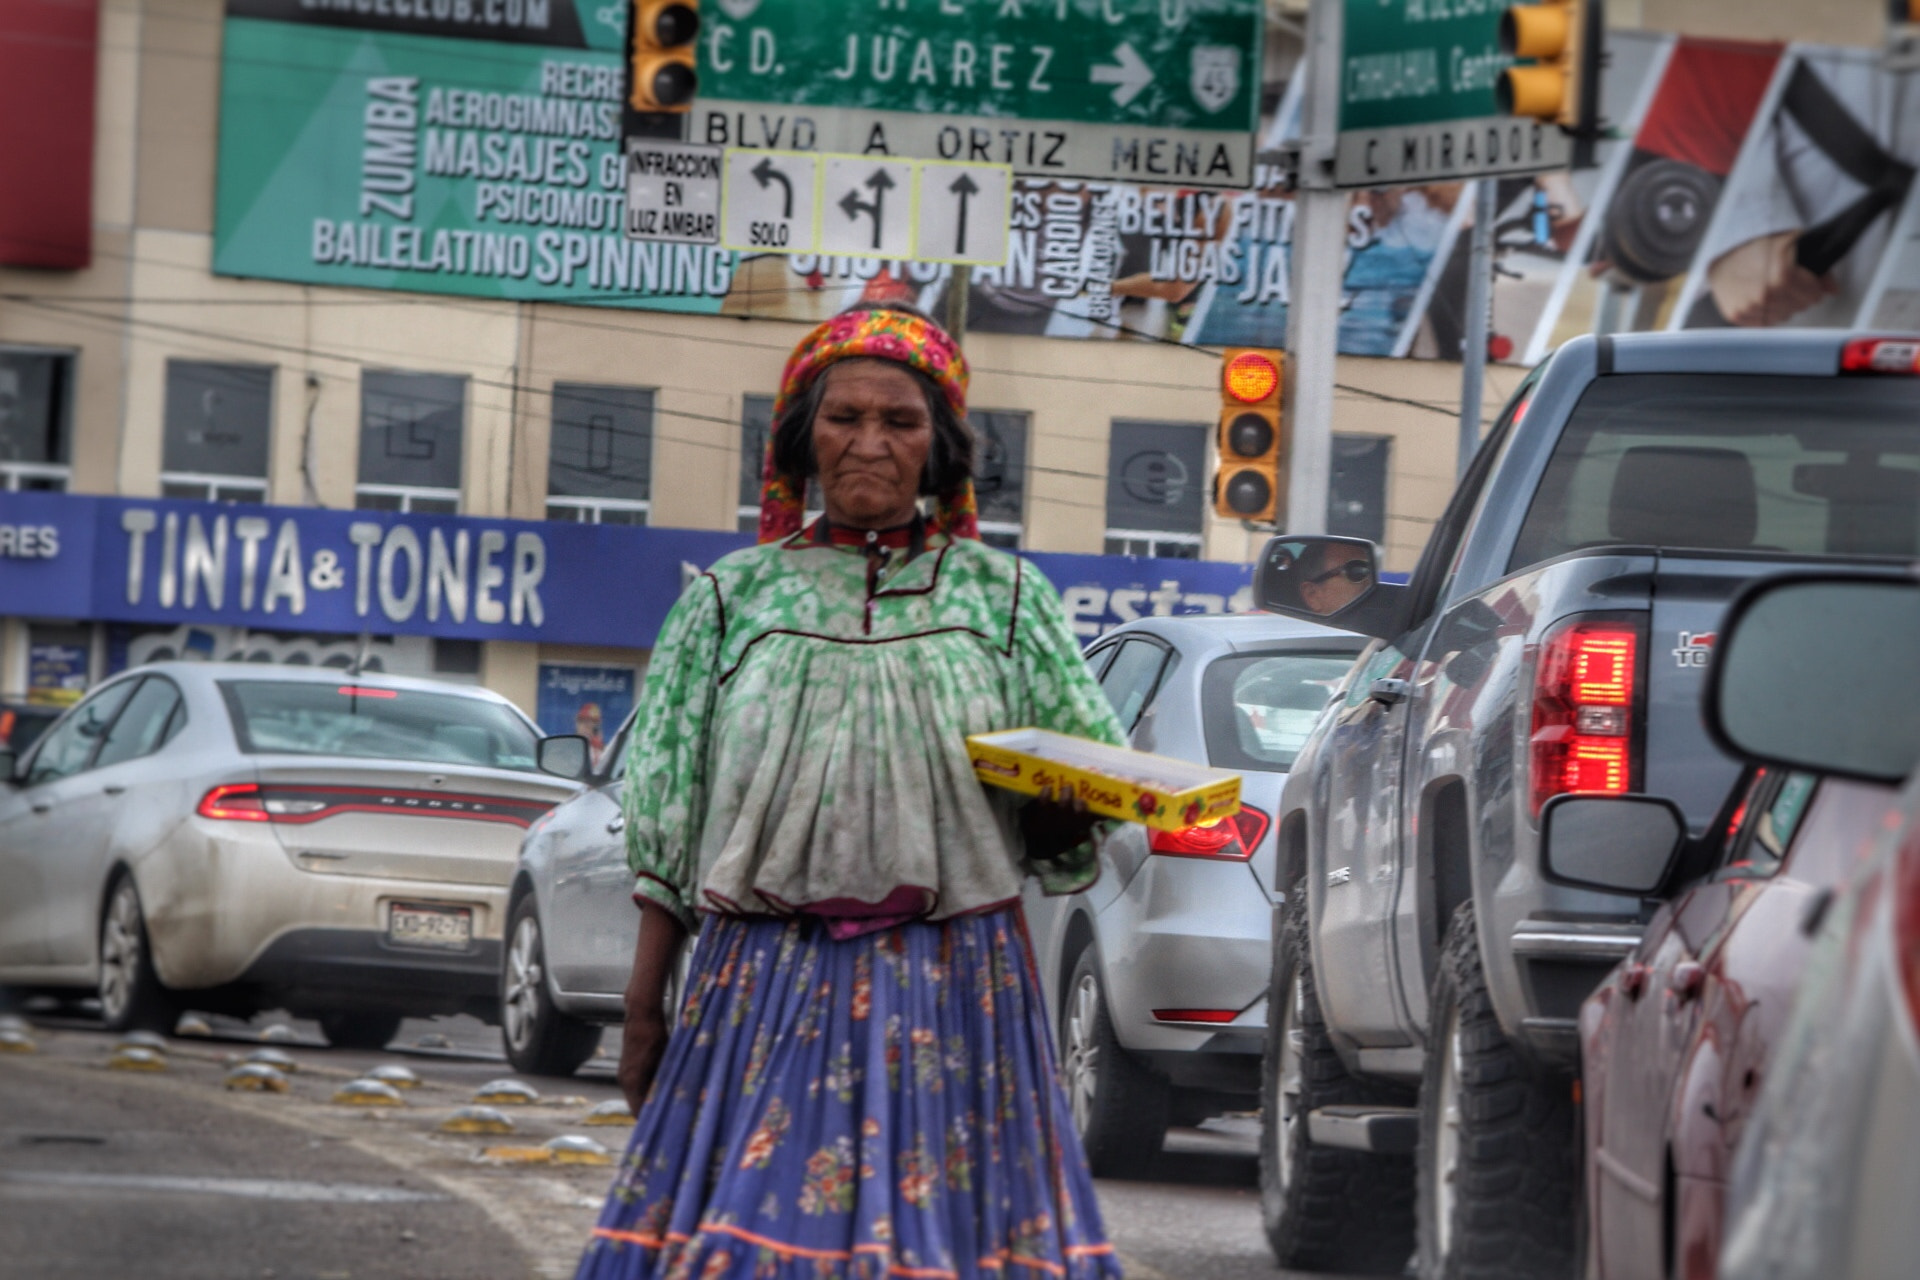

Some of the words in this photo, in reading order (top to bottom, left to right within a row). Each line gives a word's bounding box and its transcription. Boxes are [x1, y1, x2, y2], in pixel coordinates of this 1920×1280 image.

[710, 26, 786, 74] CD.
[361, 76, 417, 219] ZUMBA
[423, 129, 590, 187] MASAJES
[628, 152, 720, 179] INFRACCION
[937, 127, 1066, 167] ORTIZ
[1112, 138, 1233, 178] MENA
[1366, 138, 1378, 176] C
[1402, 122, 1542, 174] MIRADOR
[664, 182, 683, 206] EN
[1119, 190, 1224, 239] BELLY
[630, 209, 658, 234] LUZ
[661, 212, 715, 238] AMBAR
[750, 221, 789, 247] SOLO
[1041, 192, 1083, 299] CARDIO
[535, 231, 732, 295] SPINNING
[1151, 237, 1241, 285] LIGAS
[122, 509, 306, 616] TINTA
[309, 549, 344, 591] &
[348, 522, 546, 628] TONER
